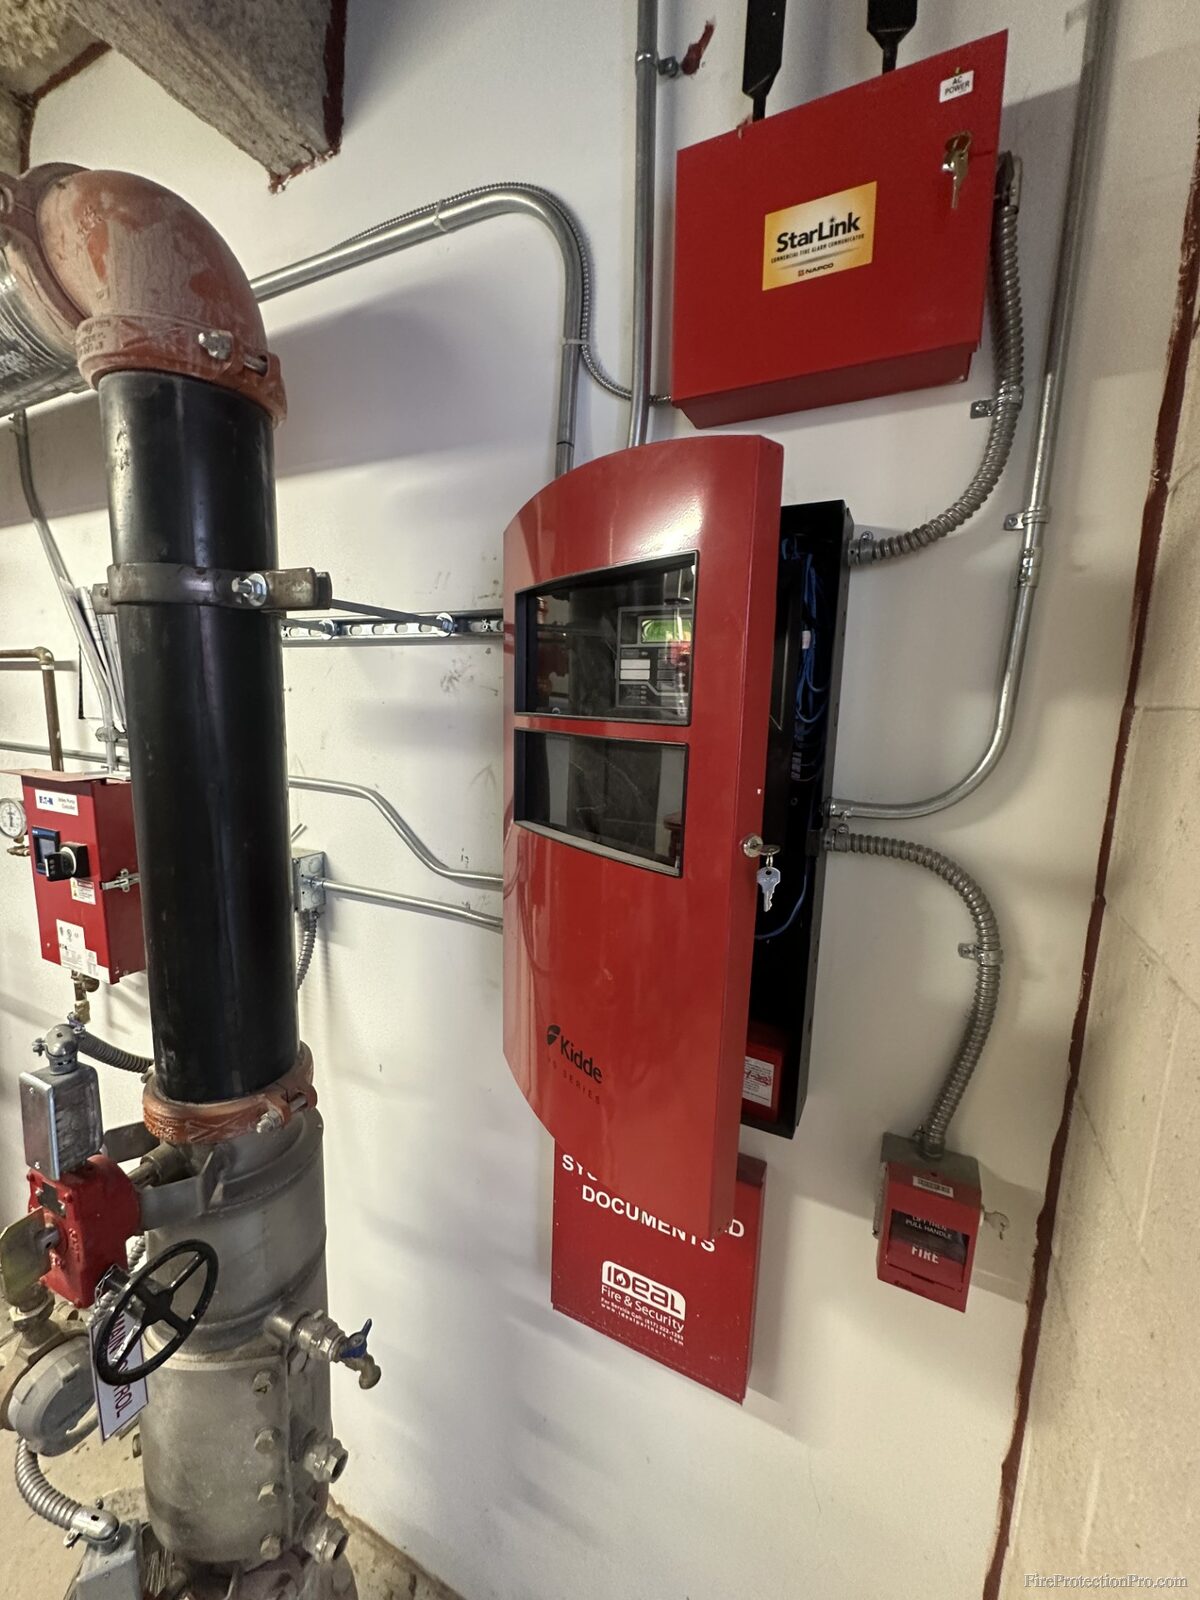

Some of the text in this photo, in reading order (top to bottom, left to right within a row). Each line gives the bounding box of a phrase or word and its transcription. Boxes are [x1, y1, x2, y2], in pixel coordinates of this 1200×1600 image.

[944, 81, 970, 95] POWER
[952, 75, 963, 84] AC
[776, 211, 861, 253] StarLink
[811, 244, 827, 253] ALARM
[828, 233, 865, 249] COMMUNICATOR
[805, 262, 834, 275] NAPCO
[560, 1035, 603, 1084] Kidde
[905, 1219, 952, 1240] PULL HANDLE
[911, 1246, 939, 1264] FIRE
[601, 1285, 684, 1333] Fire & Security
